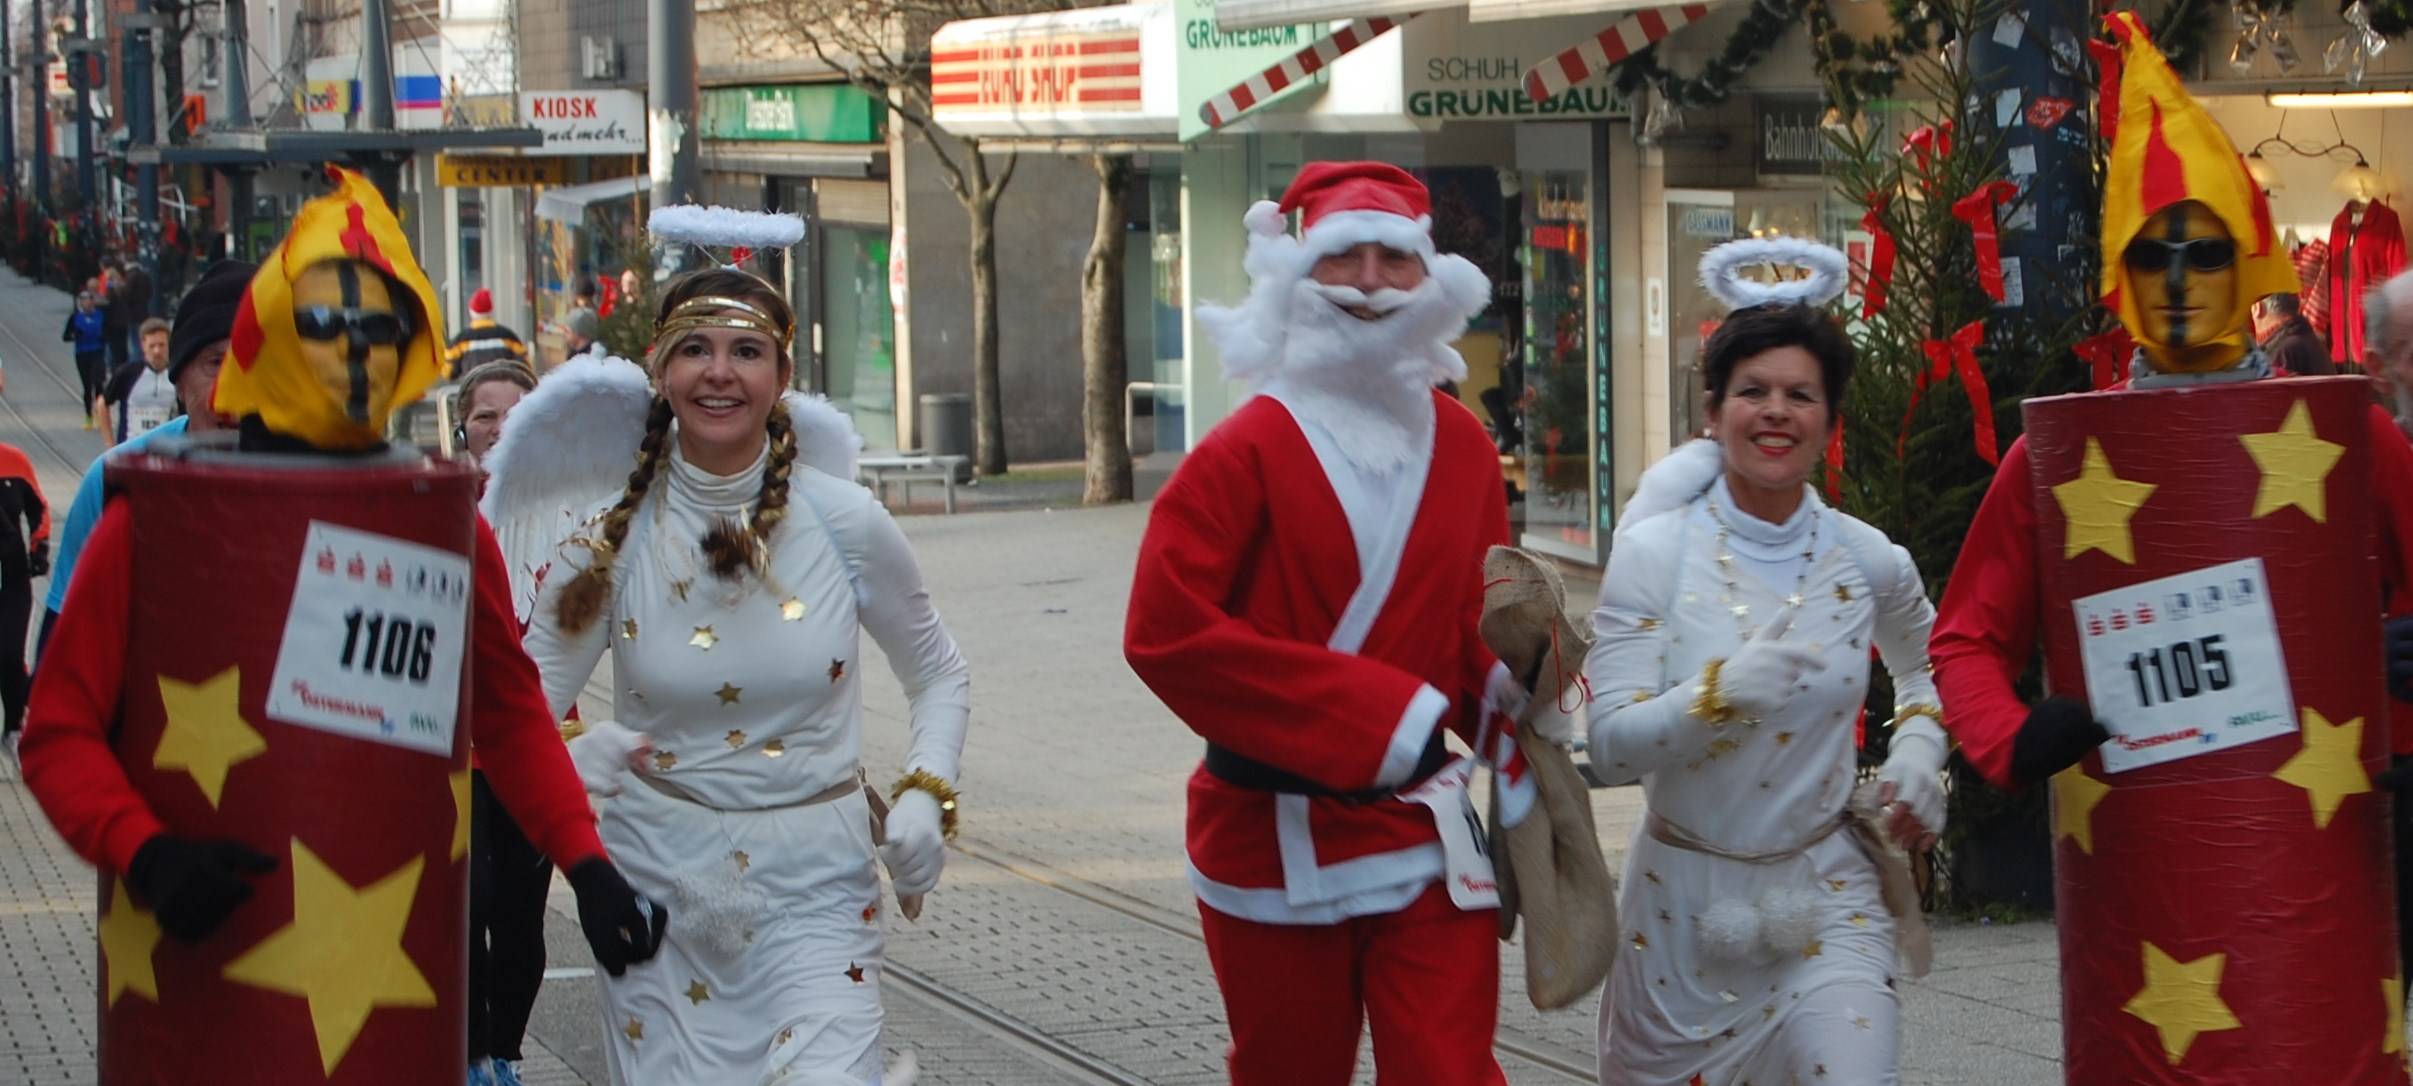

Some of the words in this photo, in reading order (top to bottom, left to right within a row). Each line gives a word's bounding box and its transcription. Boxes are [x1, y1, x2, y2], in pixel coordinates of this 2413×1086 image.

[982, 47, 1024, 103] EURO
[1031, 44, 1077, 103] SHOP
[1427, 57, 1519, 81] SCHUH
[533, 96, 598, 119] KIOSK
[339, 604, 436, 684] 1106
[2127, 632, 2233, 708] 1105
